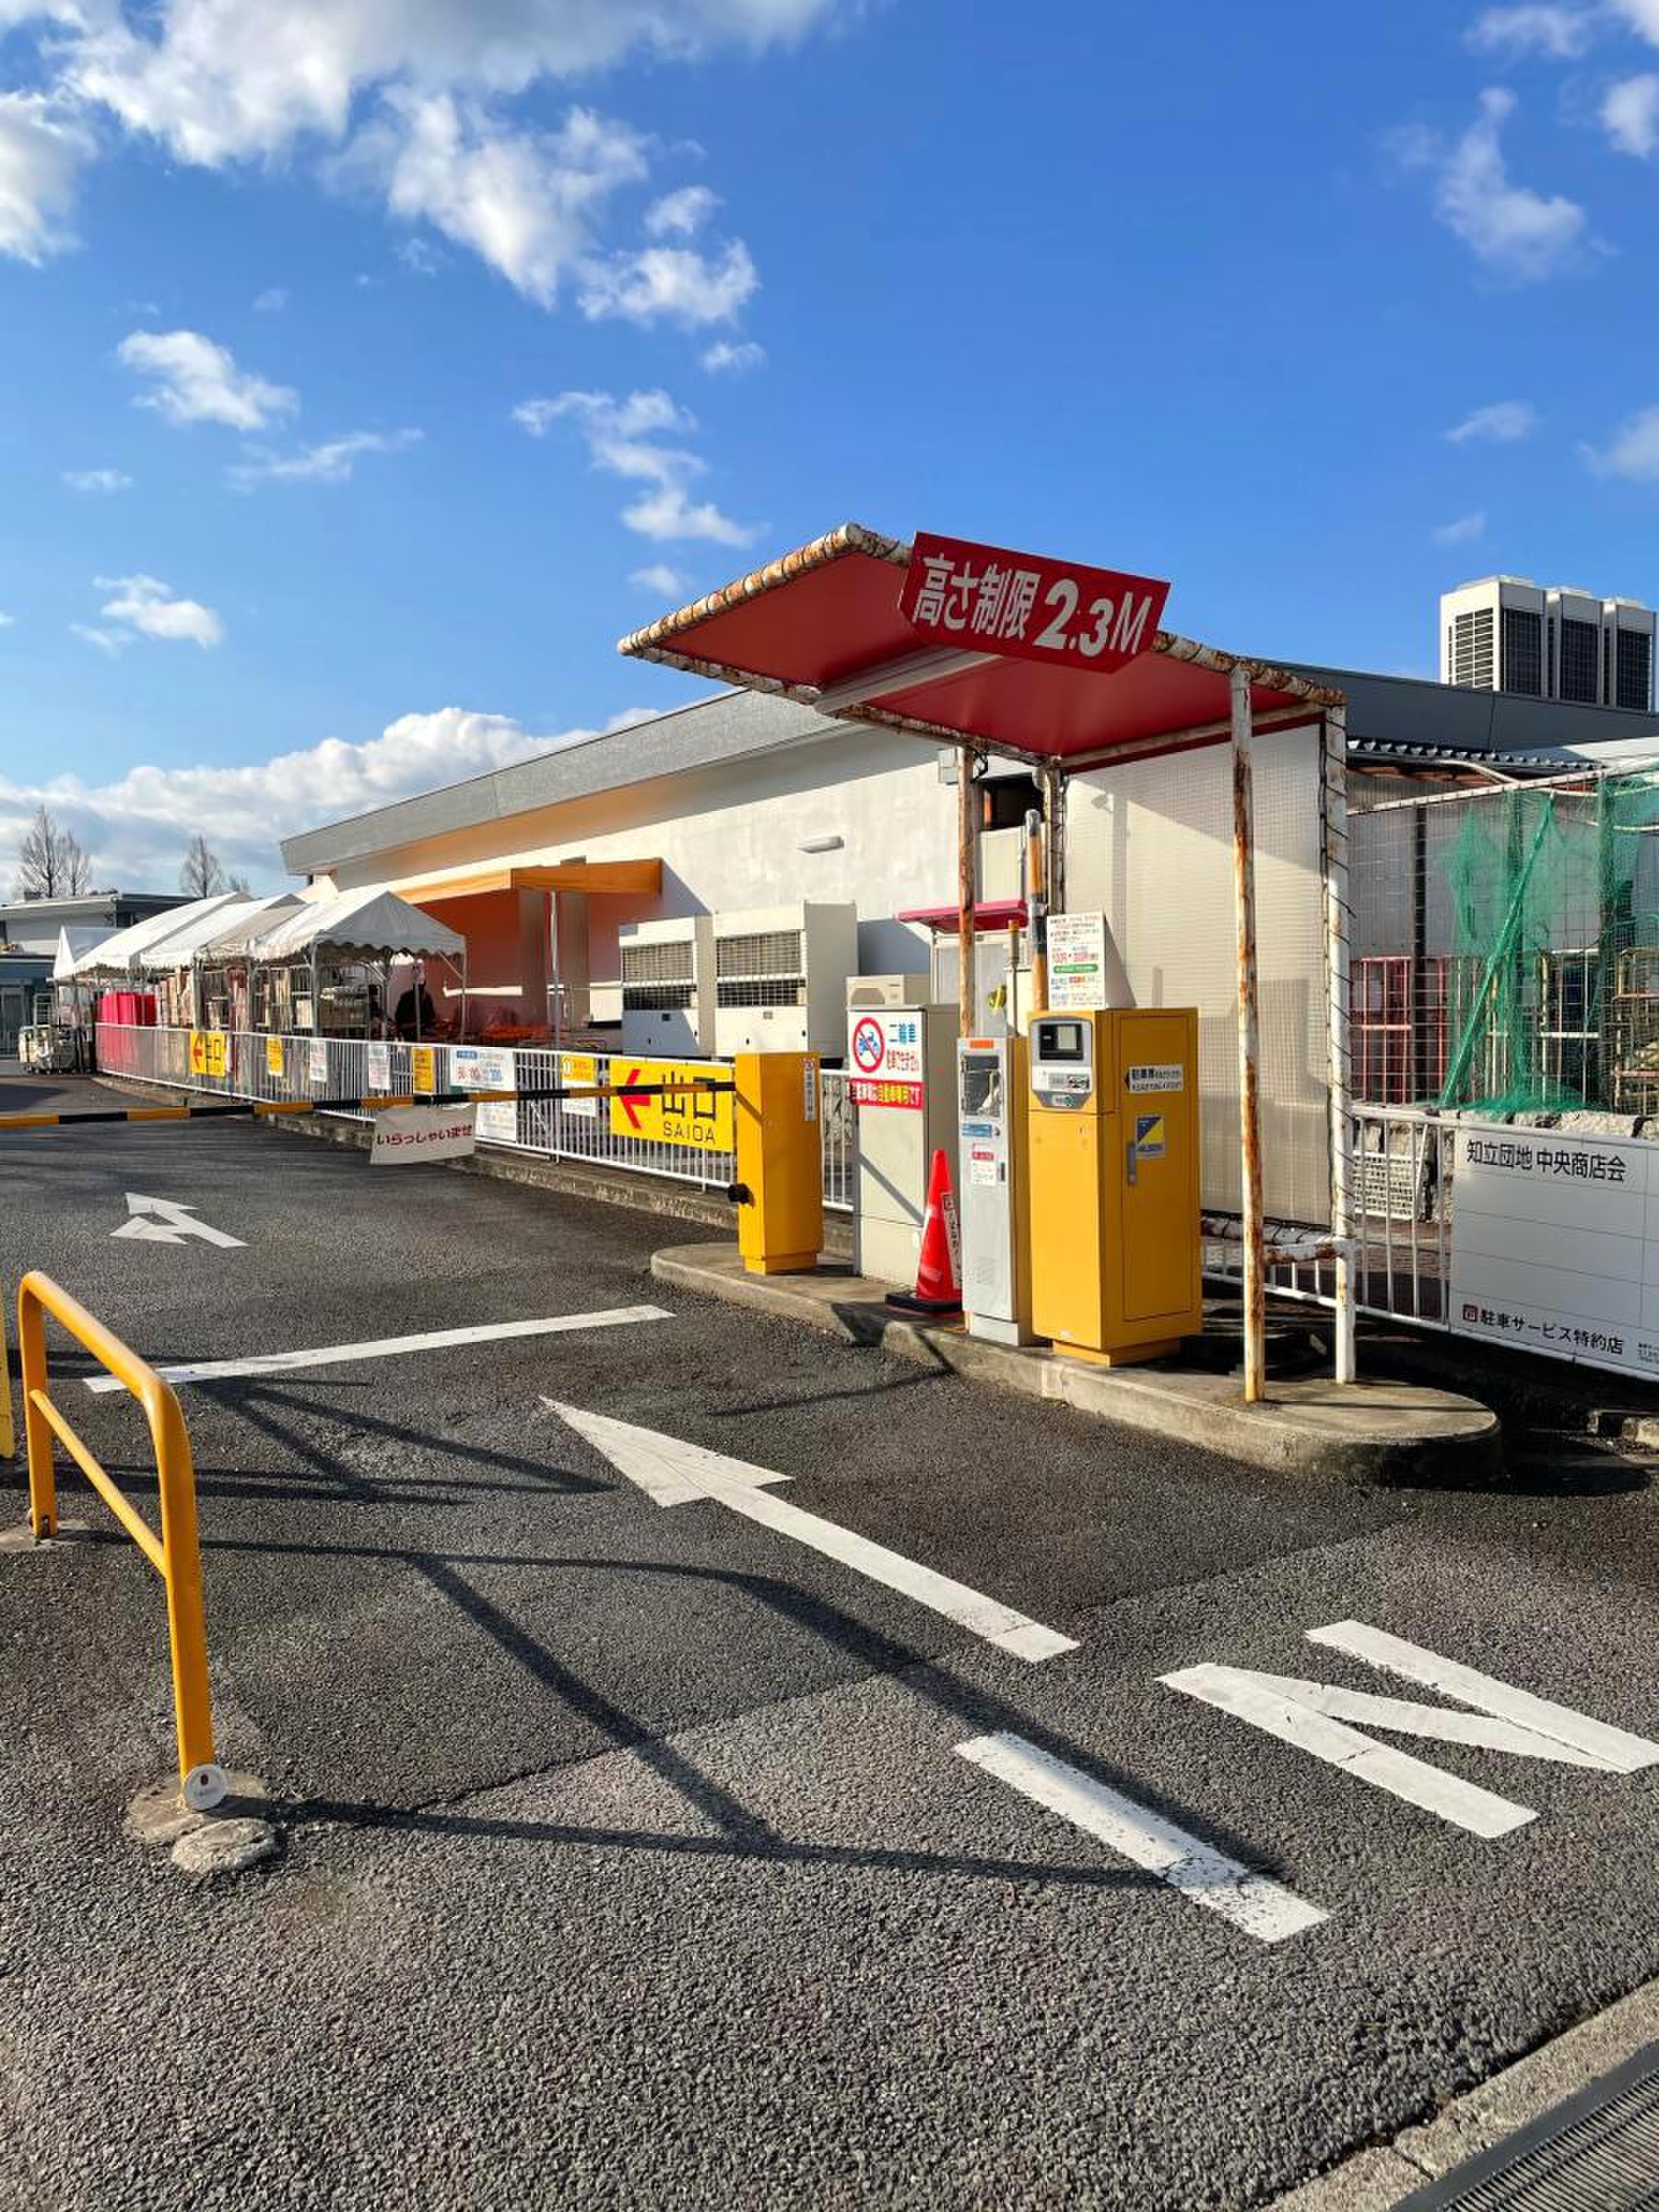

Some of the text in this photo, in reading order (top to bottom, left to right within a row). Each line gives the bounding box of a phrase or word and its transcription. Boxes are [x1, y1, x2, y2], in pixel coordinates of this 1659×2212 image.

[912, 554, 1153, 658] 高さ制限 2.3M
[663, 1070, 716, 1121] 出口
[377, 1124, 473, 1146] いらっしゃいませ
[663, 1120, 716, 1145] SAIDA
[1466, 1139, 1627, 1183] 知立団地 中央商店会
[1480, 1308, 1624, 1356] 駐車サービス特約店
